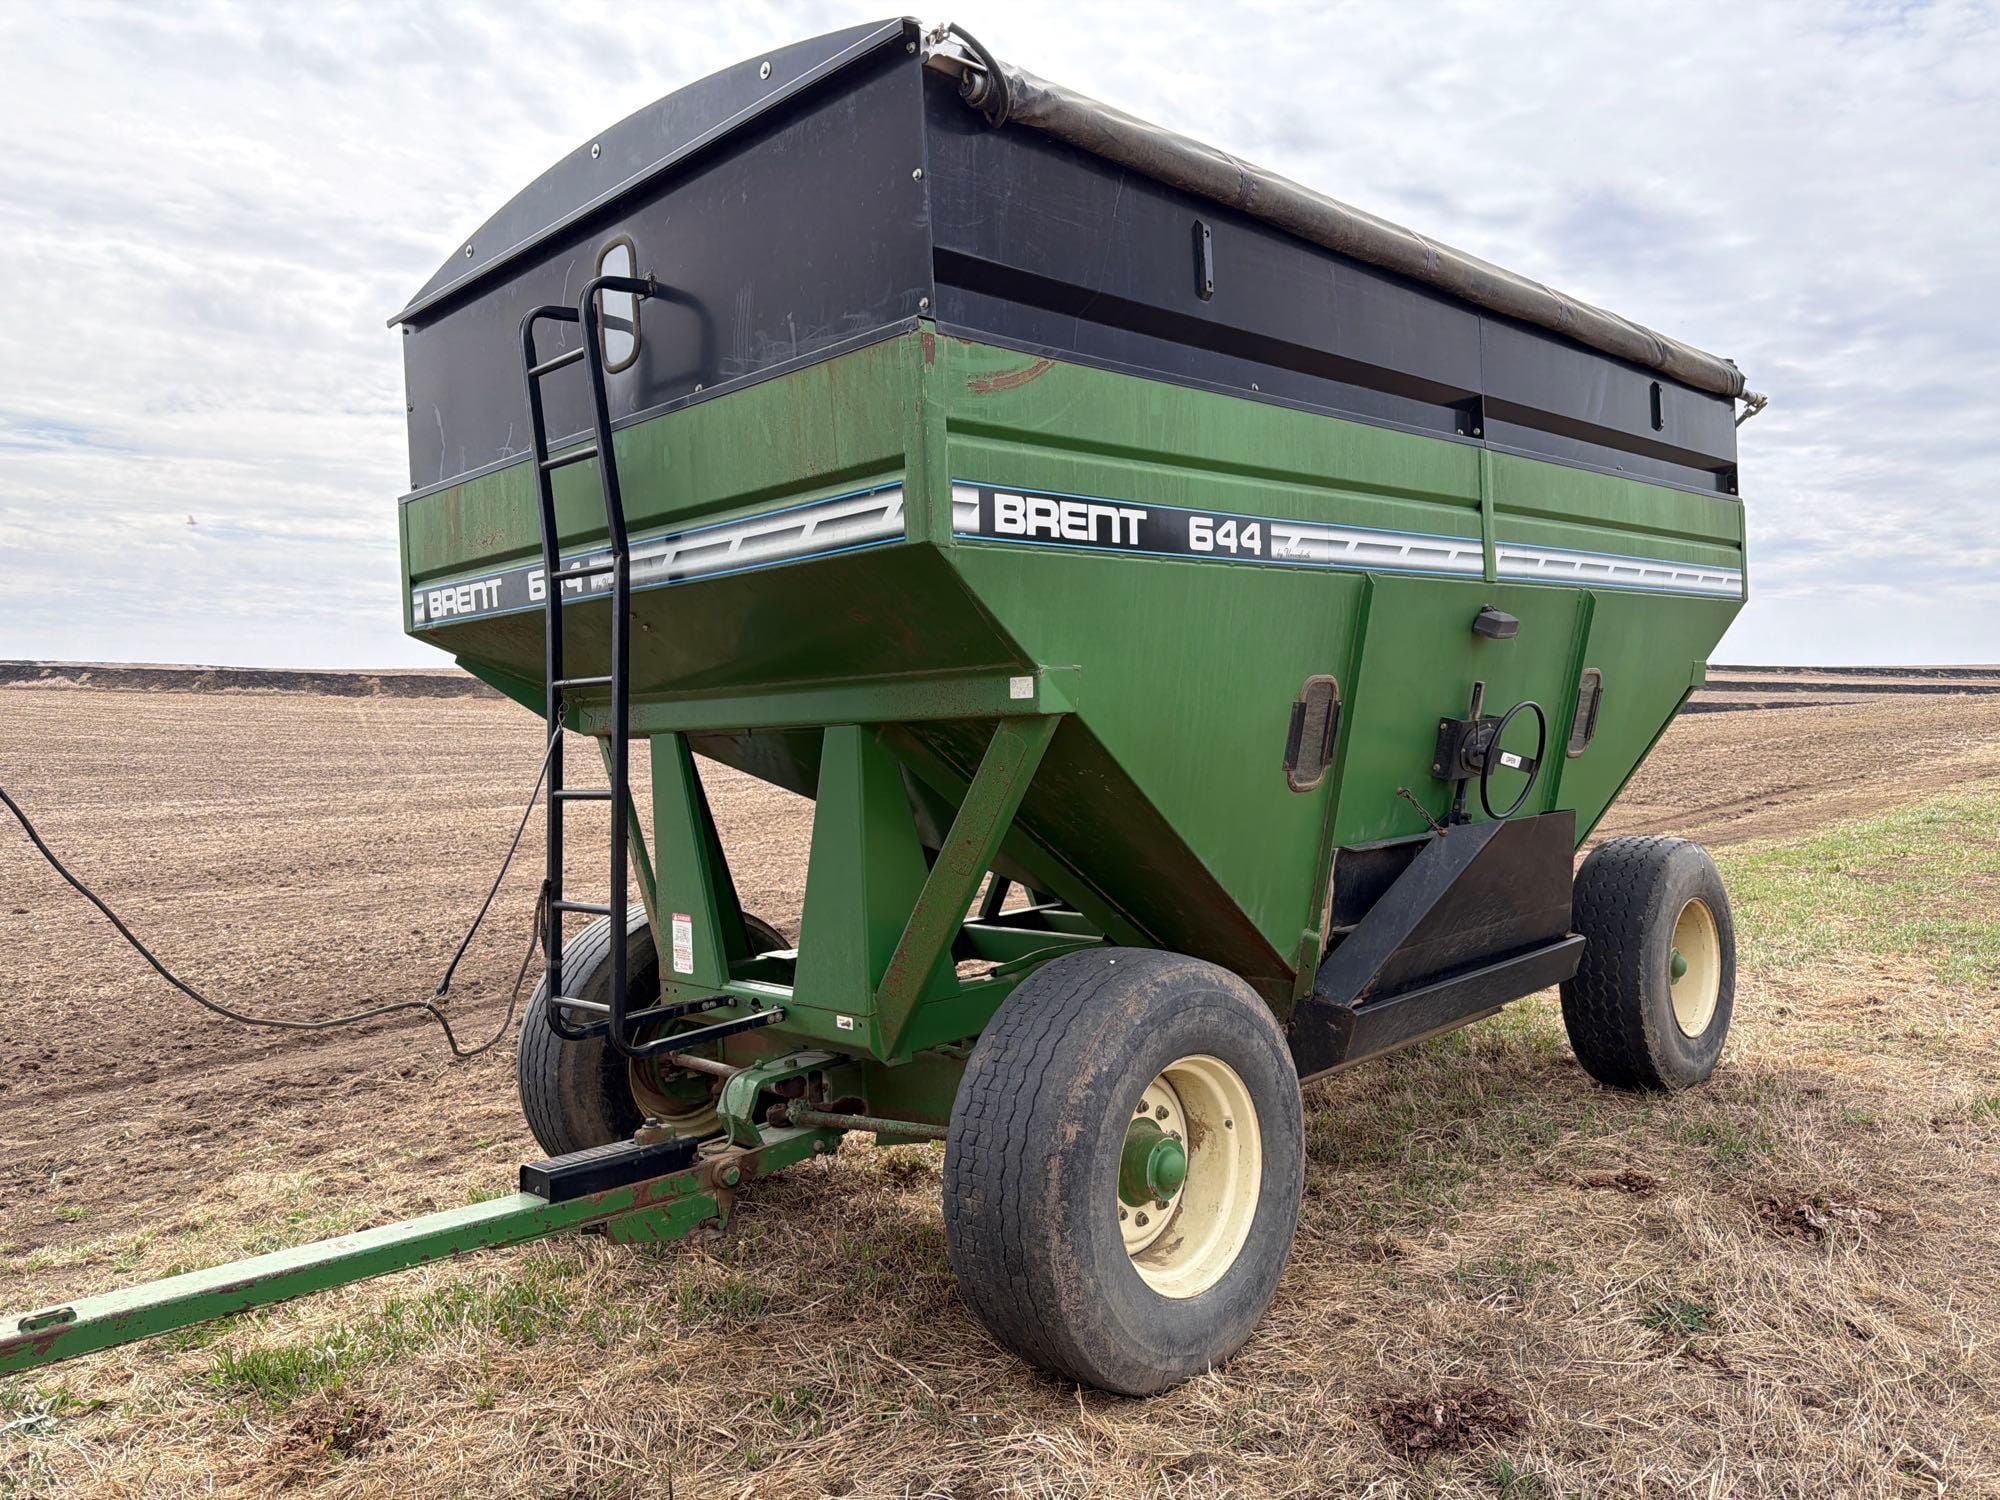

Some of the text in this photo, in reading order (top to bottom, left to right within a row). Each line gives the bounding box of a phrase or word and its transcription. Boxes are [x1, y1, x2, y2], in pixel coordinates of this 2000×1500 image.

[993, 492, 1262, 556] BRENT 644
[428, 561, 583, 618] BRENT 64
